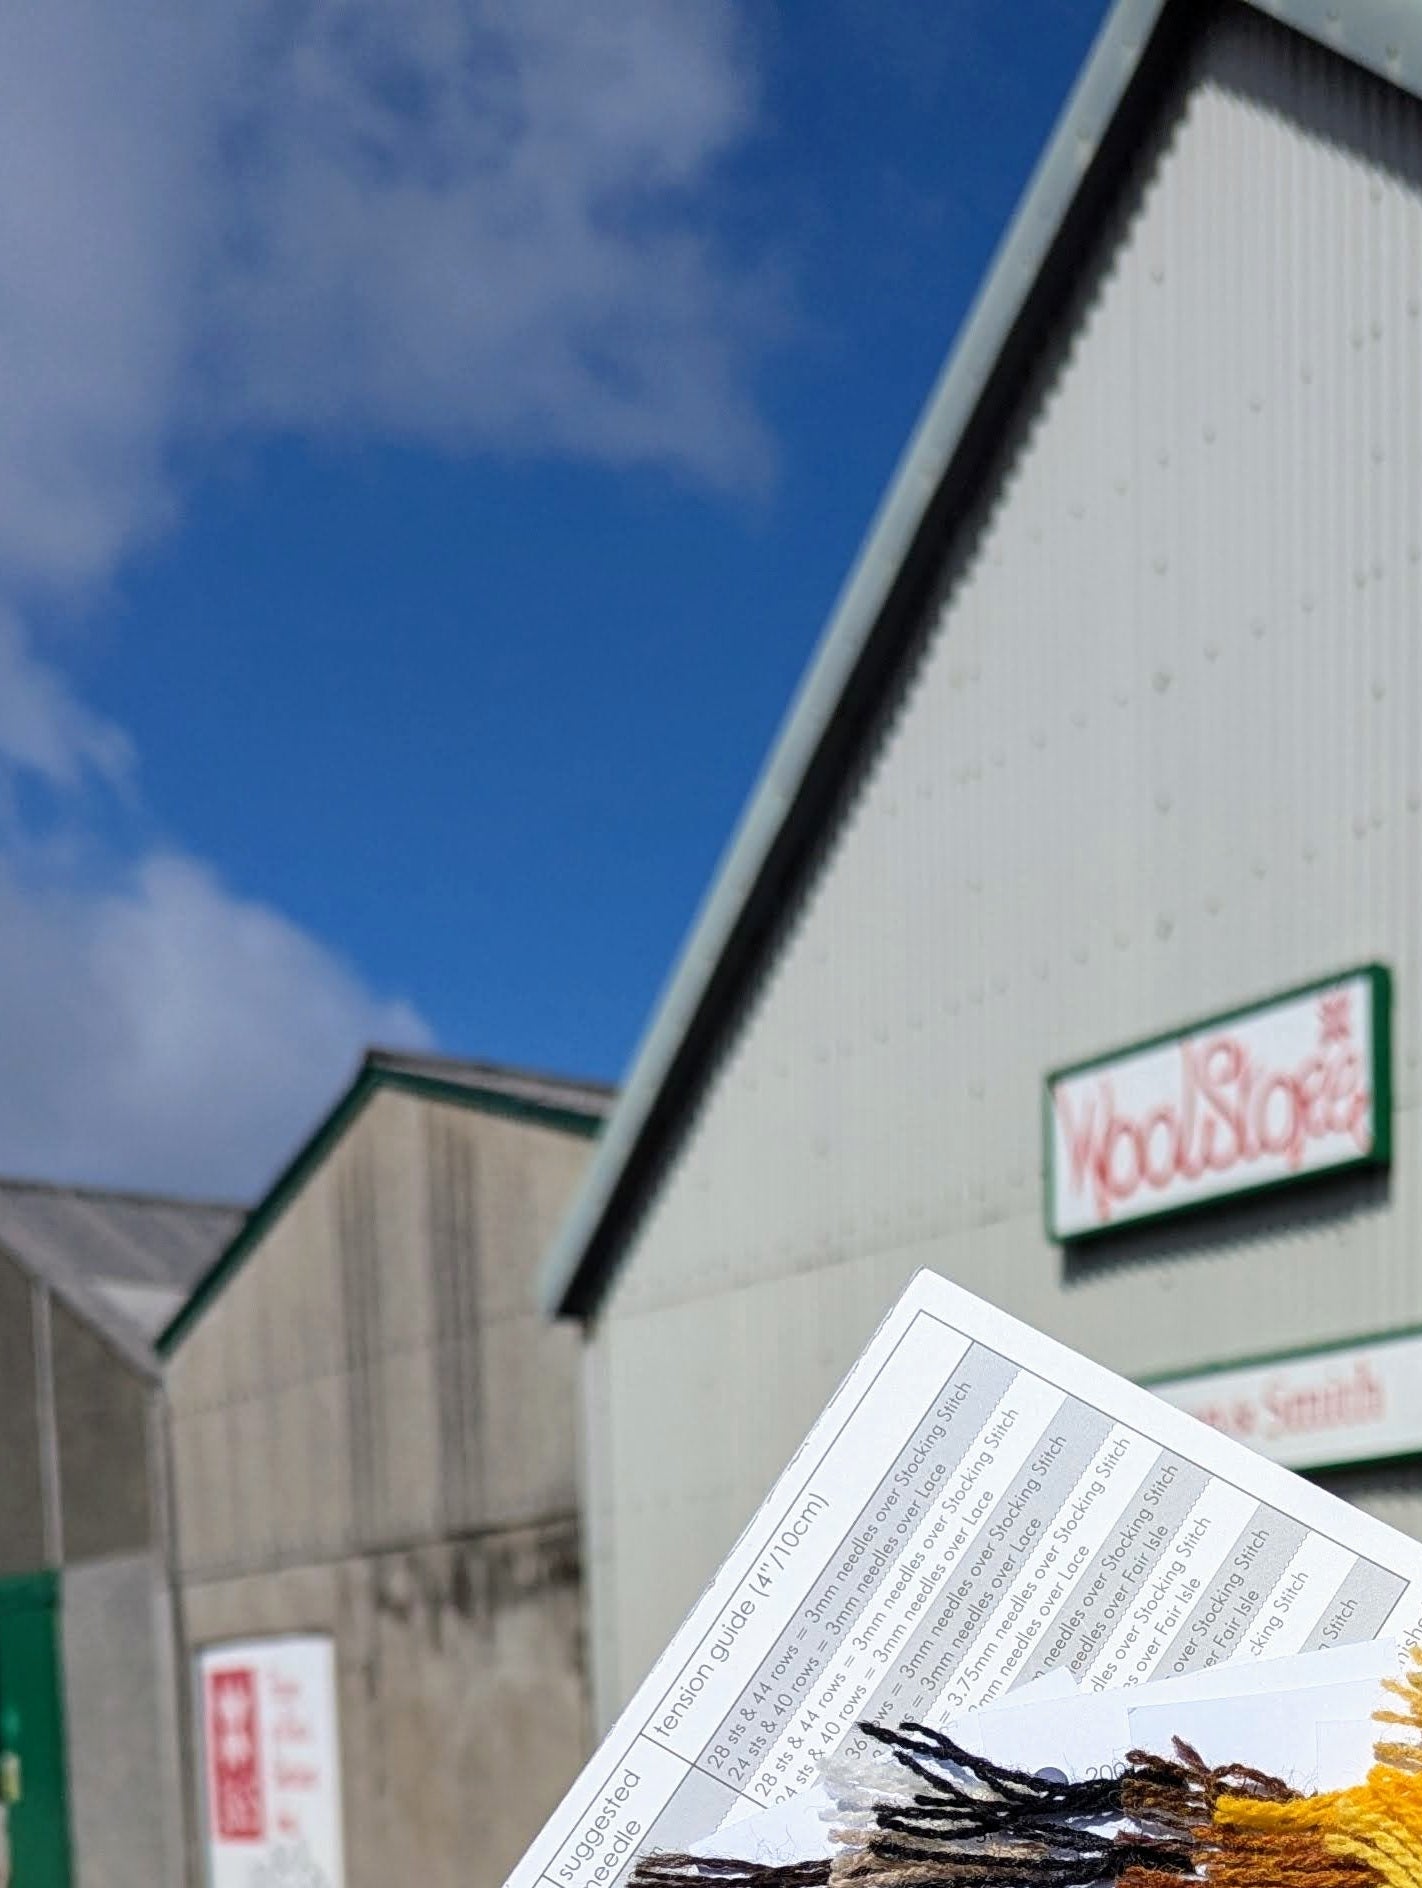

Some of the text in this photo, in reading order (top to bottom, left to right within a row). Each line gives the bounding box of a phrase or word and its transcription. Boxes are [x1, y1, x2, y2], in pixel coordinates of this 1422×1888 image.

[706, 1382, 971, 1770] 28 sts & 44 rows 3mm needles over Stocking Stitch
[726, 1461, 948, 1782] 24 sts & 40 rows 3mm needles over Lace
[754, 1410, 1019, 1797] 28 sts & 44 rows 3mm needles over Stocking Stitch
[796, 1764, 814, 1784] sts
[820, 1722, 840, 1744] 40
[839, 1685, 866, 1720] rows
[873, 1624, 907, 1663] 3mm
[904, 1564, 946, 1621] needles
[944, 1527, 969, 1561] over
[962, 1491, 993, 1526] Lace
[842, 1432, 1067, 1763] 36 3mm needles over Stocking Stitch
[920, 1518, 1043, 1693] 3mm needles over Lace
[948, 1439, 1130, 1706] 3.75mm needles over Stocking Stitch
[1000, 1619, 1041, 1676] needles
[1040, 1582, 1064, 1616] over
[1058, 1546, 1089, 1580] Lace
[1036, 1462, 1178, 1671] needles over Stocking Stitch
[1102, 1520, 1173, 1623] over Fair Isle
[1115, 1624, 1140, 1659] over
[1133, 1561, 1186, 1624] Stocking
[1176, 1518, 1211, 1558] Stitch
[1136, 1579, 1200, 1671] over Fair Isle
[1171, 1527, 1269, 1675] over Stocking Stitch
[1212, 1586, 1262, 1651] Fair Isle
[1274, 1573, 1309, 1613] Stitch
[1320, 1600, 1358, 1642] Stitch
[653, 1664, 714, 1737] tension
[711, 1601, 755, 1662] guide
[559, 1769, 641, 1881] suggested
